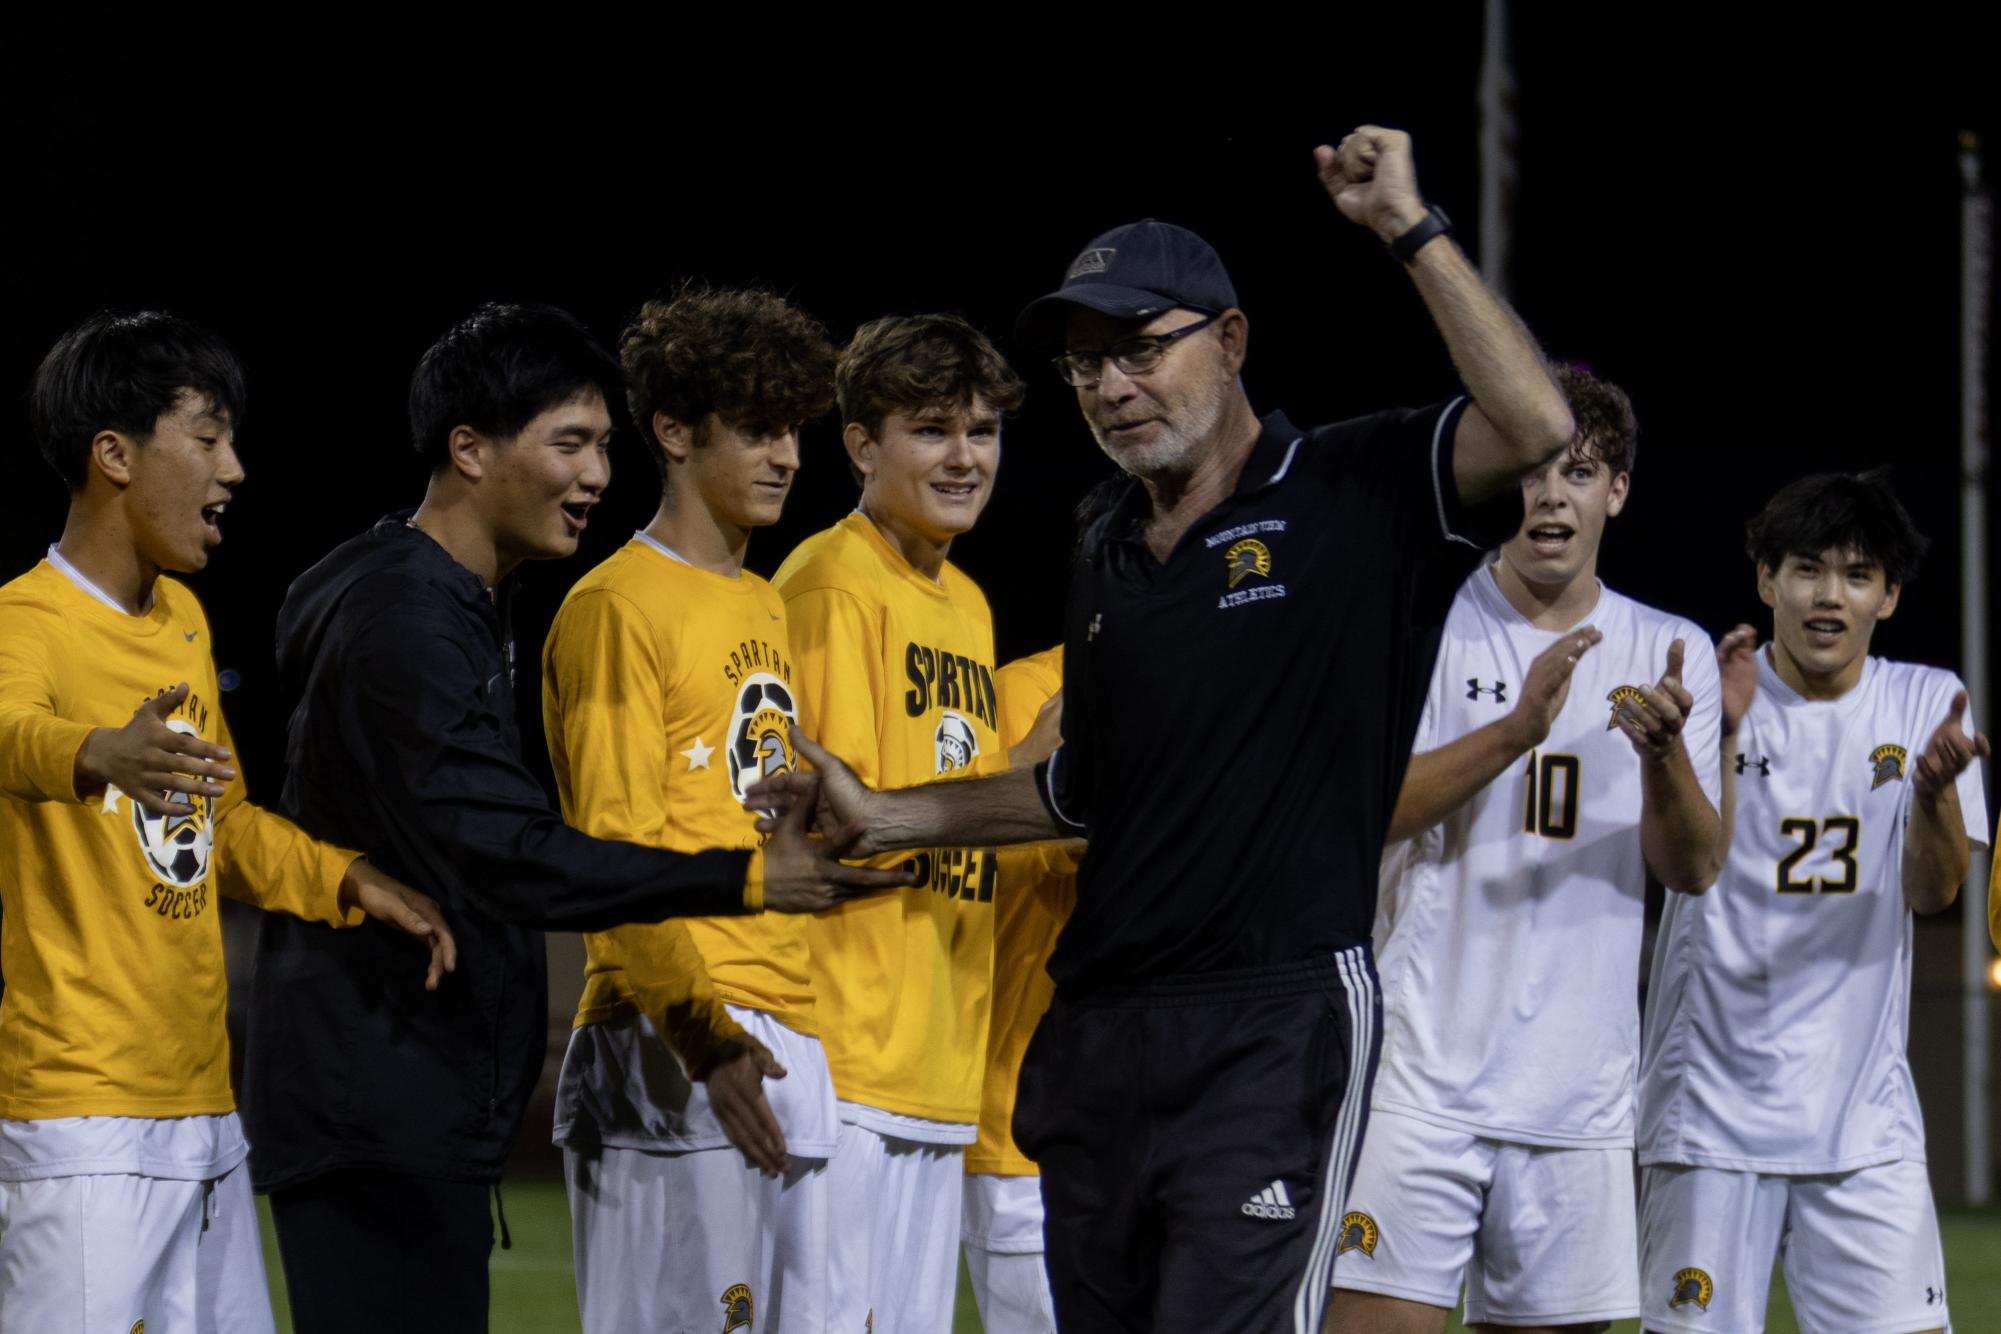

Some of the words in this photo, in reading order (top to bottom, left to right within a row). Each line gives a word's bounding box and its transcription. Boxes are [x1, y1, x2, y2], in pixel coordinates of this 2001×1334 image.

[1218, 584, 1286, 609] ATHLETICS
[724, 639, 791, 687] SPARTAN
[1524, 747, 1580, 840] 10
[1776, 816, 1859, 894] 23
[144, 882, 208, 920] SOCCER
[1241, 1203, 1295, 1219] adidas
